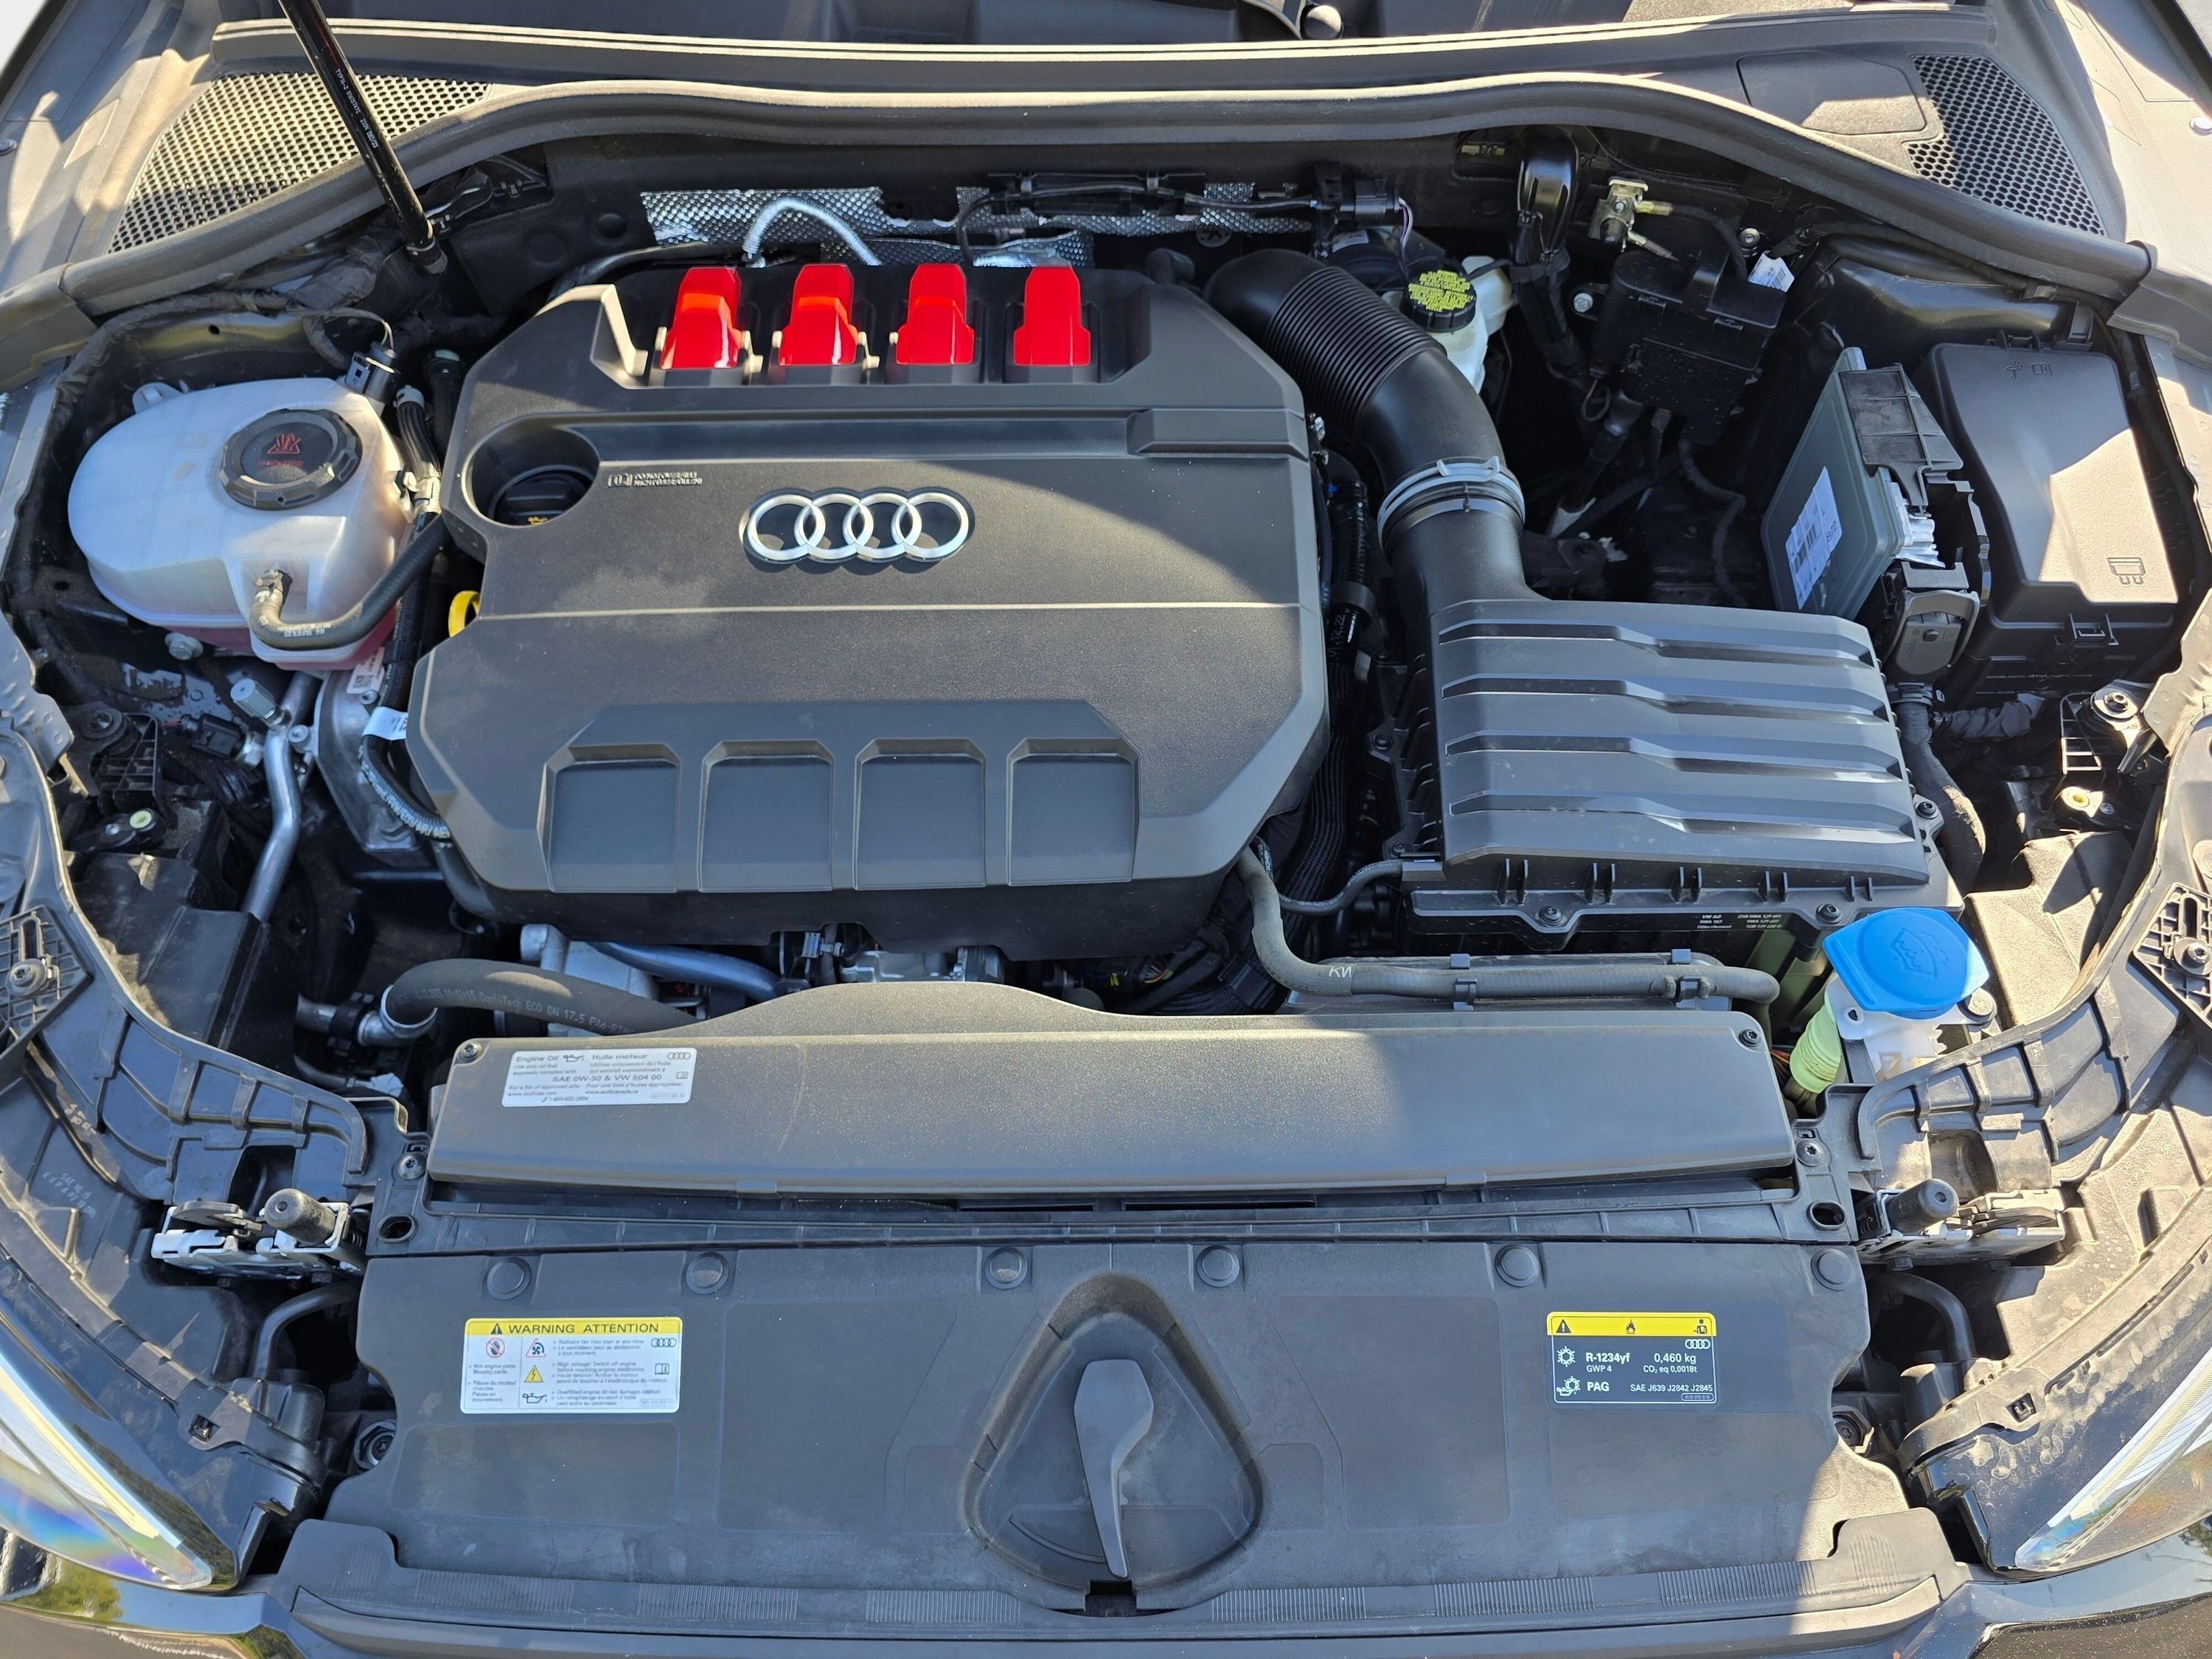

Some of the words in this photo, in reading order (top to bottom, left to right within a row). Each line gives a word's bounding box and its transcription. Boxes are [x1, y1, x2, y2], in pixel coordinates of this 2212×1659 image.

[509, 1324, 575, 1334] WARNING
[583, 1323, 659, 1333] ATTENTION
[1585, 1352, 1631, 1364] R-1234yf
[1654, 1353, 1682, 1363] 0,460
[1684, 1353, 1697, 1365] kg
[1659, 1366, 1669, 1374] eq
[1670, 1366, 1697, 1374] 0,0018t
[1587, 1382, 1610, 1391] PAG
[1630, 1384, 1646, 1392] SAE
[1647, 1384, 1666, 1392] J639
[1667, 1384, 1689, 1392] J2842
[1691, 1384, 1713, 1392] J2845
